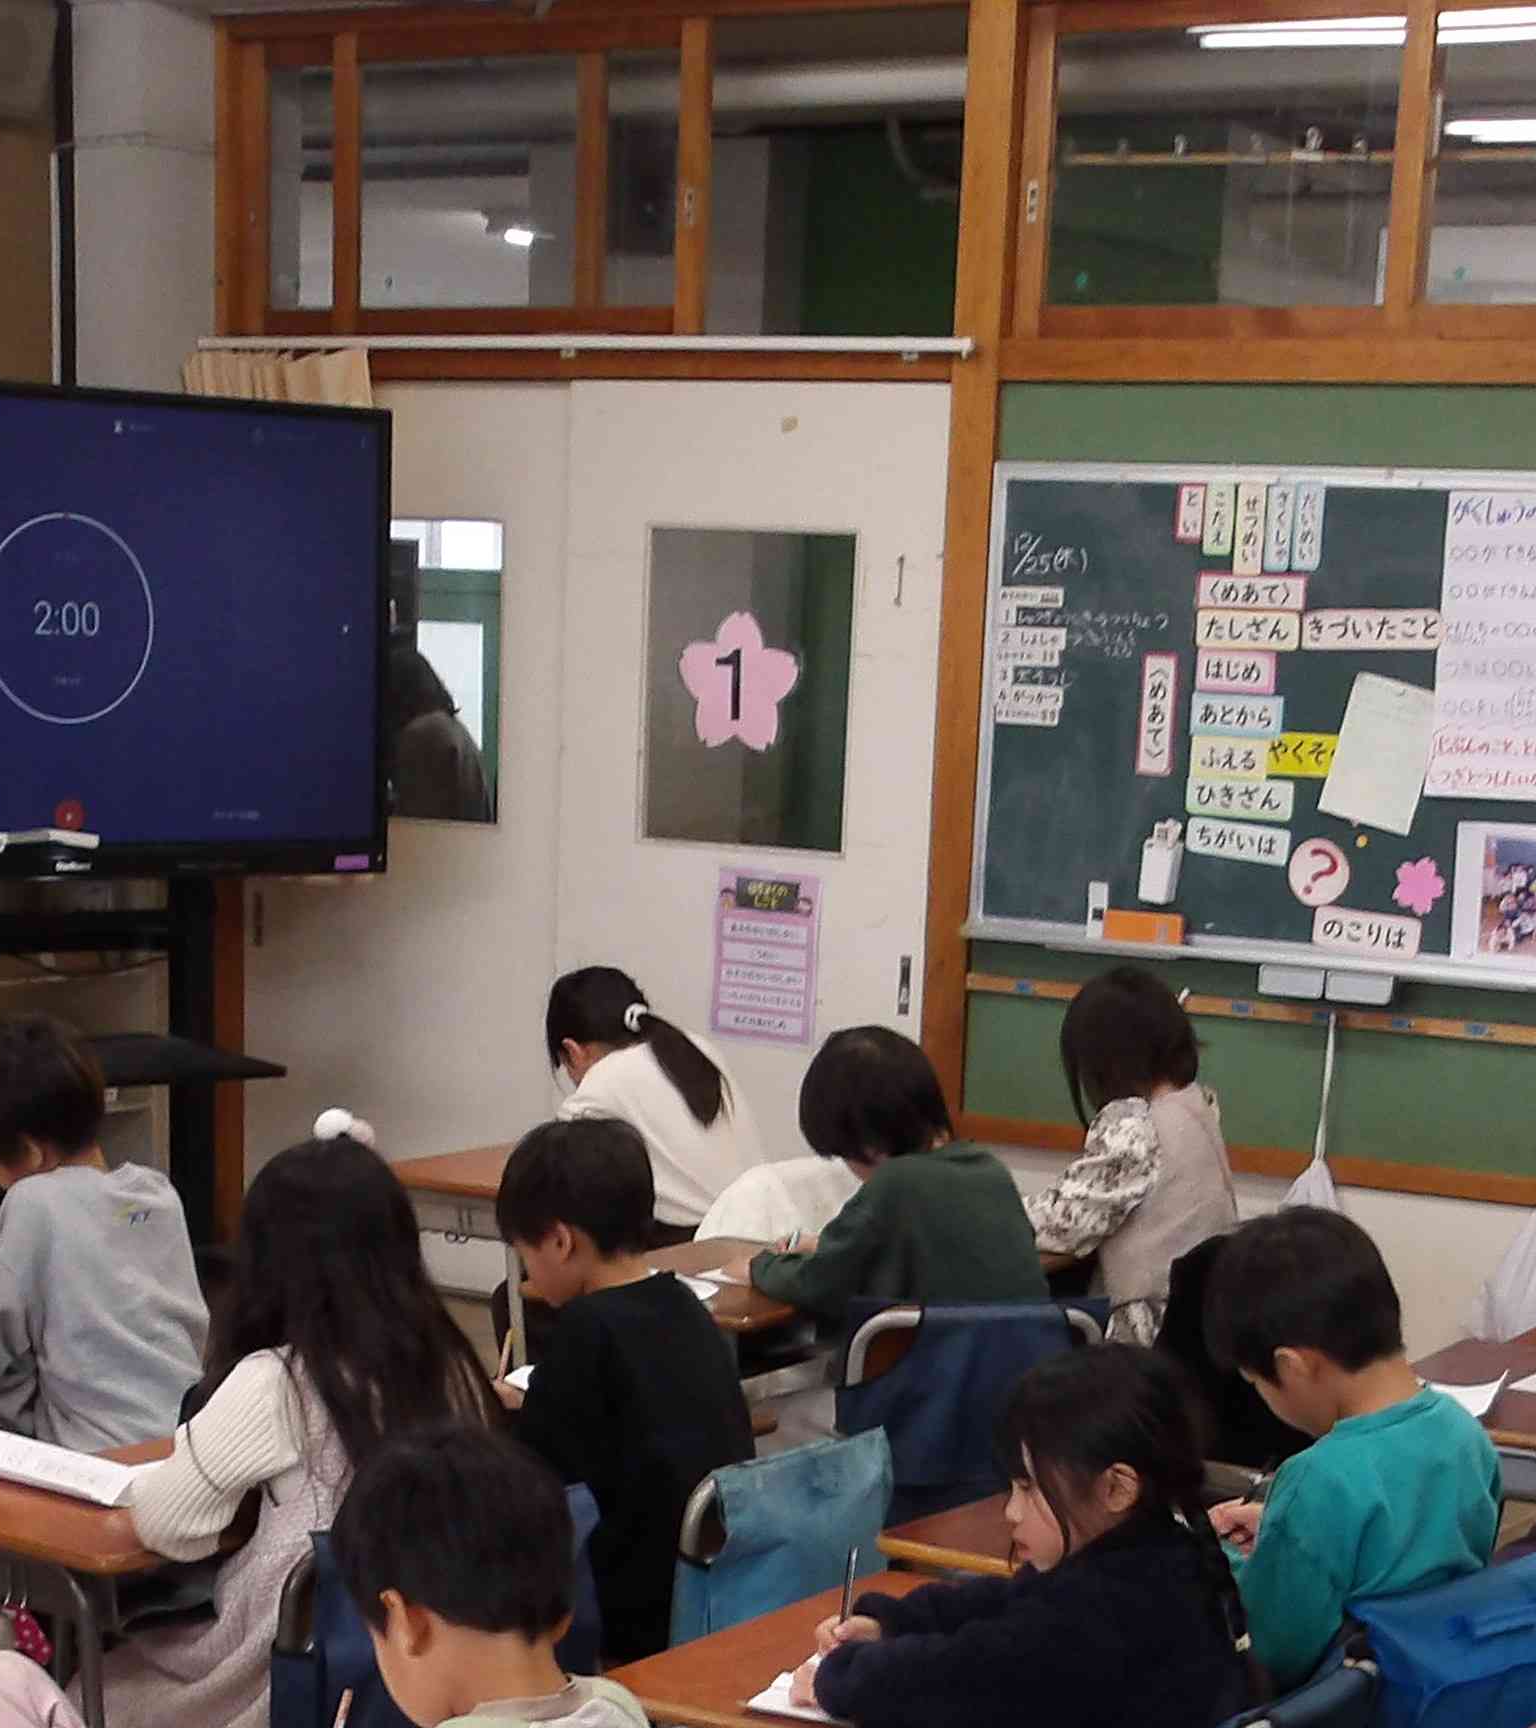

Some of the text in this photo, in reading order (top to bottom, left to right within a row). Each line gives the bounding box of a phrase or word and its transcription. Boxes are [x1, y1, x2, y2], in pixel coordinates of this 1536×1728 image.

[33, 600, 100, 637] 2:00
[1205, 617, 1290, 642] たしざん
[1307, 615, 1439, 643] きづいたこと
[1204, 659, 1262, 681] はじめ
[714, 649, 741, 721] 1
[1198, 707, 1272, 730] あとから
[1200, 748, 1257, 770] ふえる
[1267, 739, 1337, 767] やくそ
[1194, 784, 1282, 811] ひきざん
[1195, 826, 1277, 856] ちがいは
[1302, 848, 1340, 896] ?
[1322, 918, 1408, 950] のこりは
